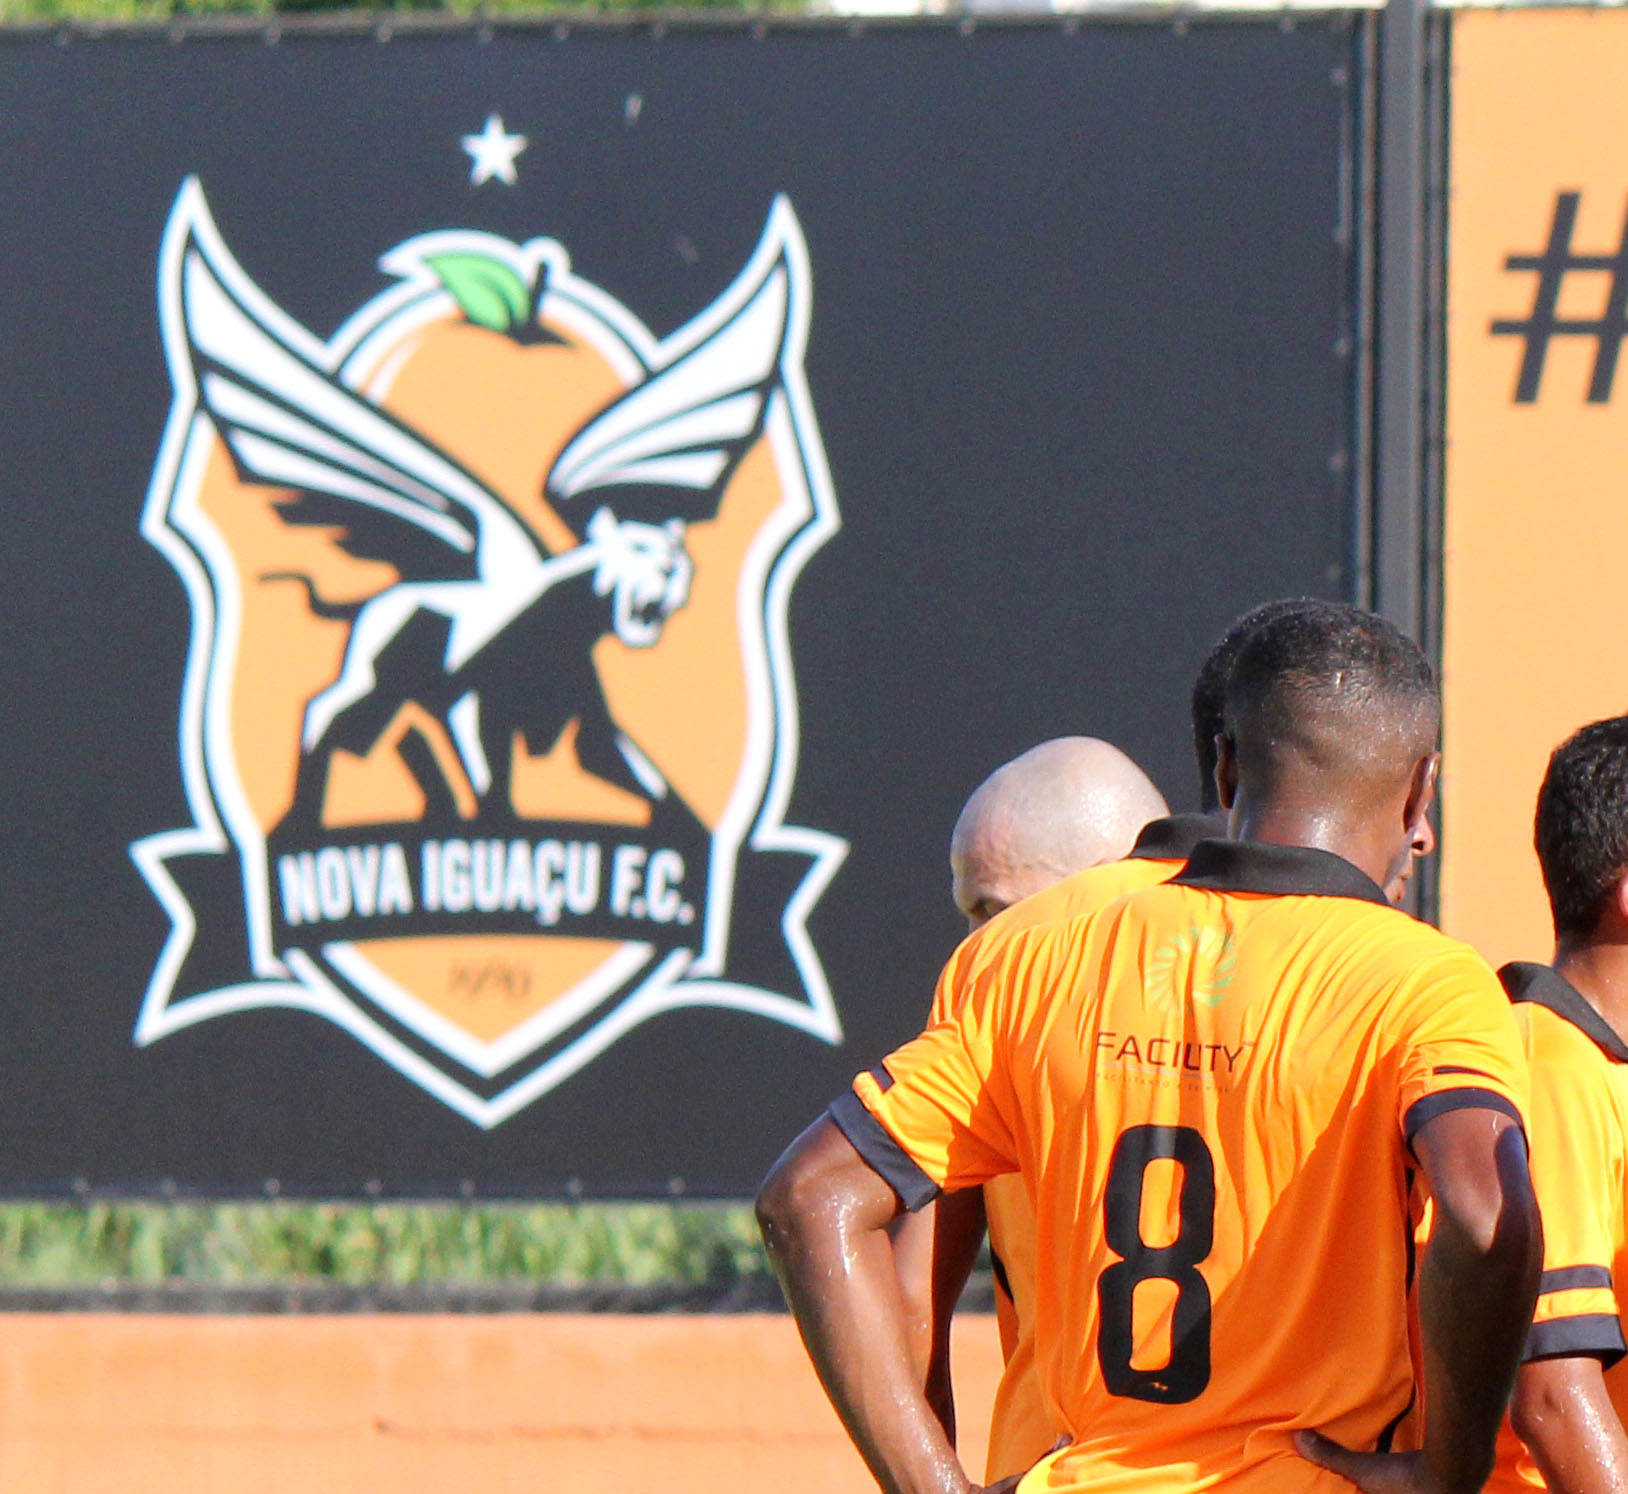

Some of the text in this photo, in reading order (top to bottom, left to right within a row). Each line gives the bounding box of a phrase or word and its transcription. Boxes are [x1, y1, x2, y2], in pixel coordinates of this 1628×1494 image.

[277, 838, 695, 926] NOVA IGUAÇU F.C.
[1096, 1031, 1244, 1073] FACILITY
[1098, 1124, 1216, 1405] 8
